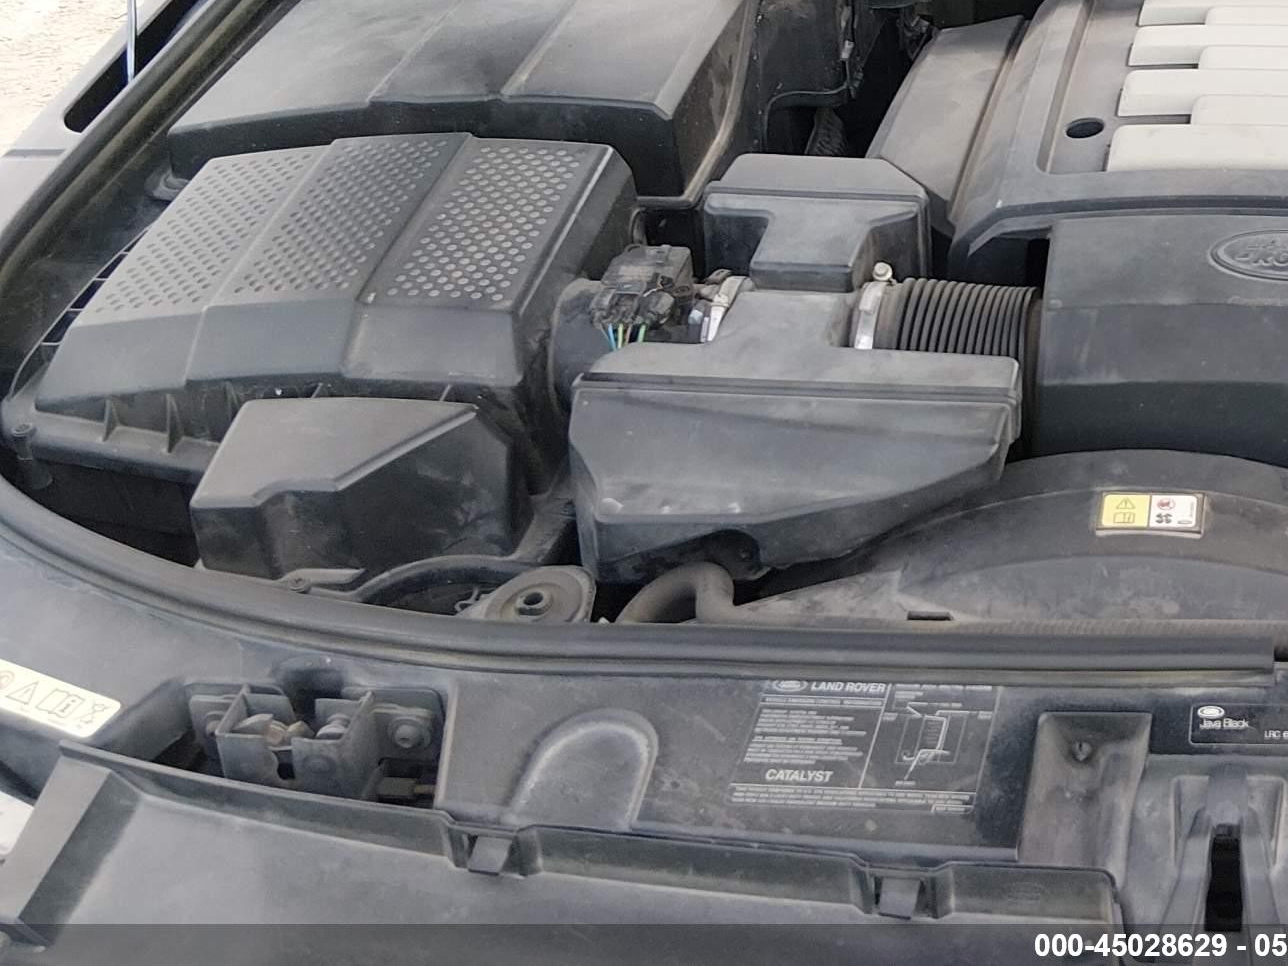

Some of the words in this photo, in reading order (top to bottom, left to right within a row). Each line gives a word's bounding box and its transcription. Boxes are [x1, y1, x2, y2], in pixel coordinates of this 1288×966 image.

[810, 682, 846, 692] LAND
[844, 682, 886, 693] ROVER
[764, 768, 834, 783] CATALYST
